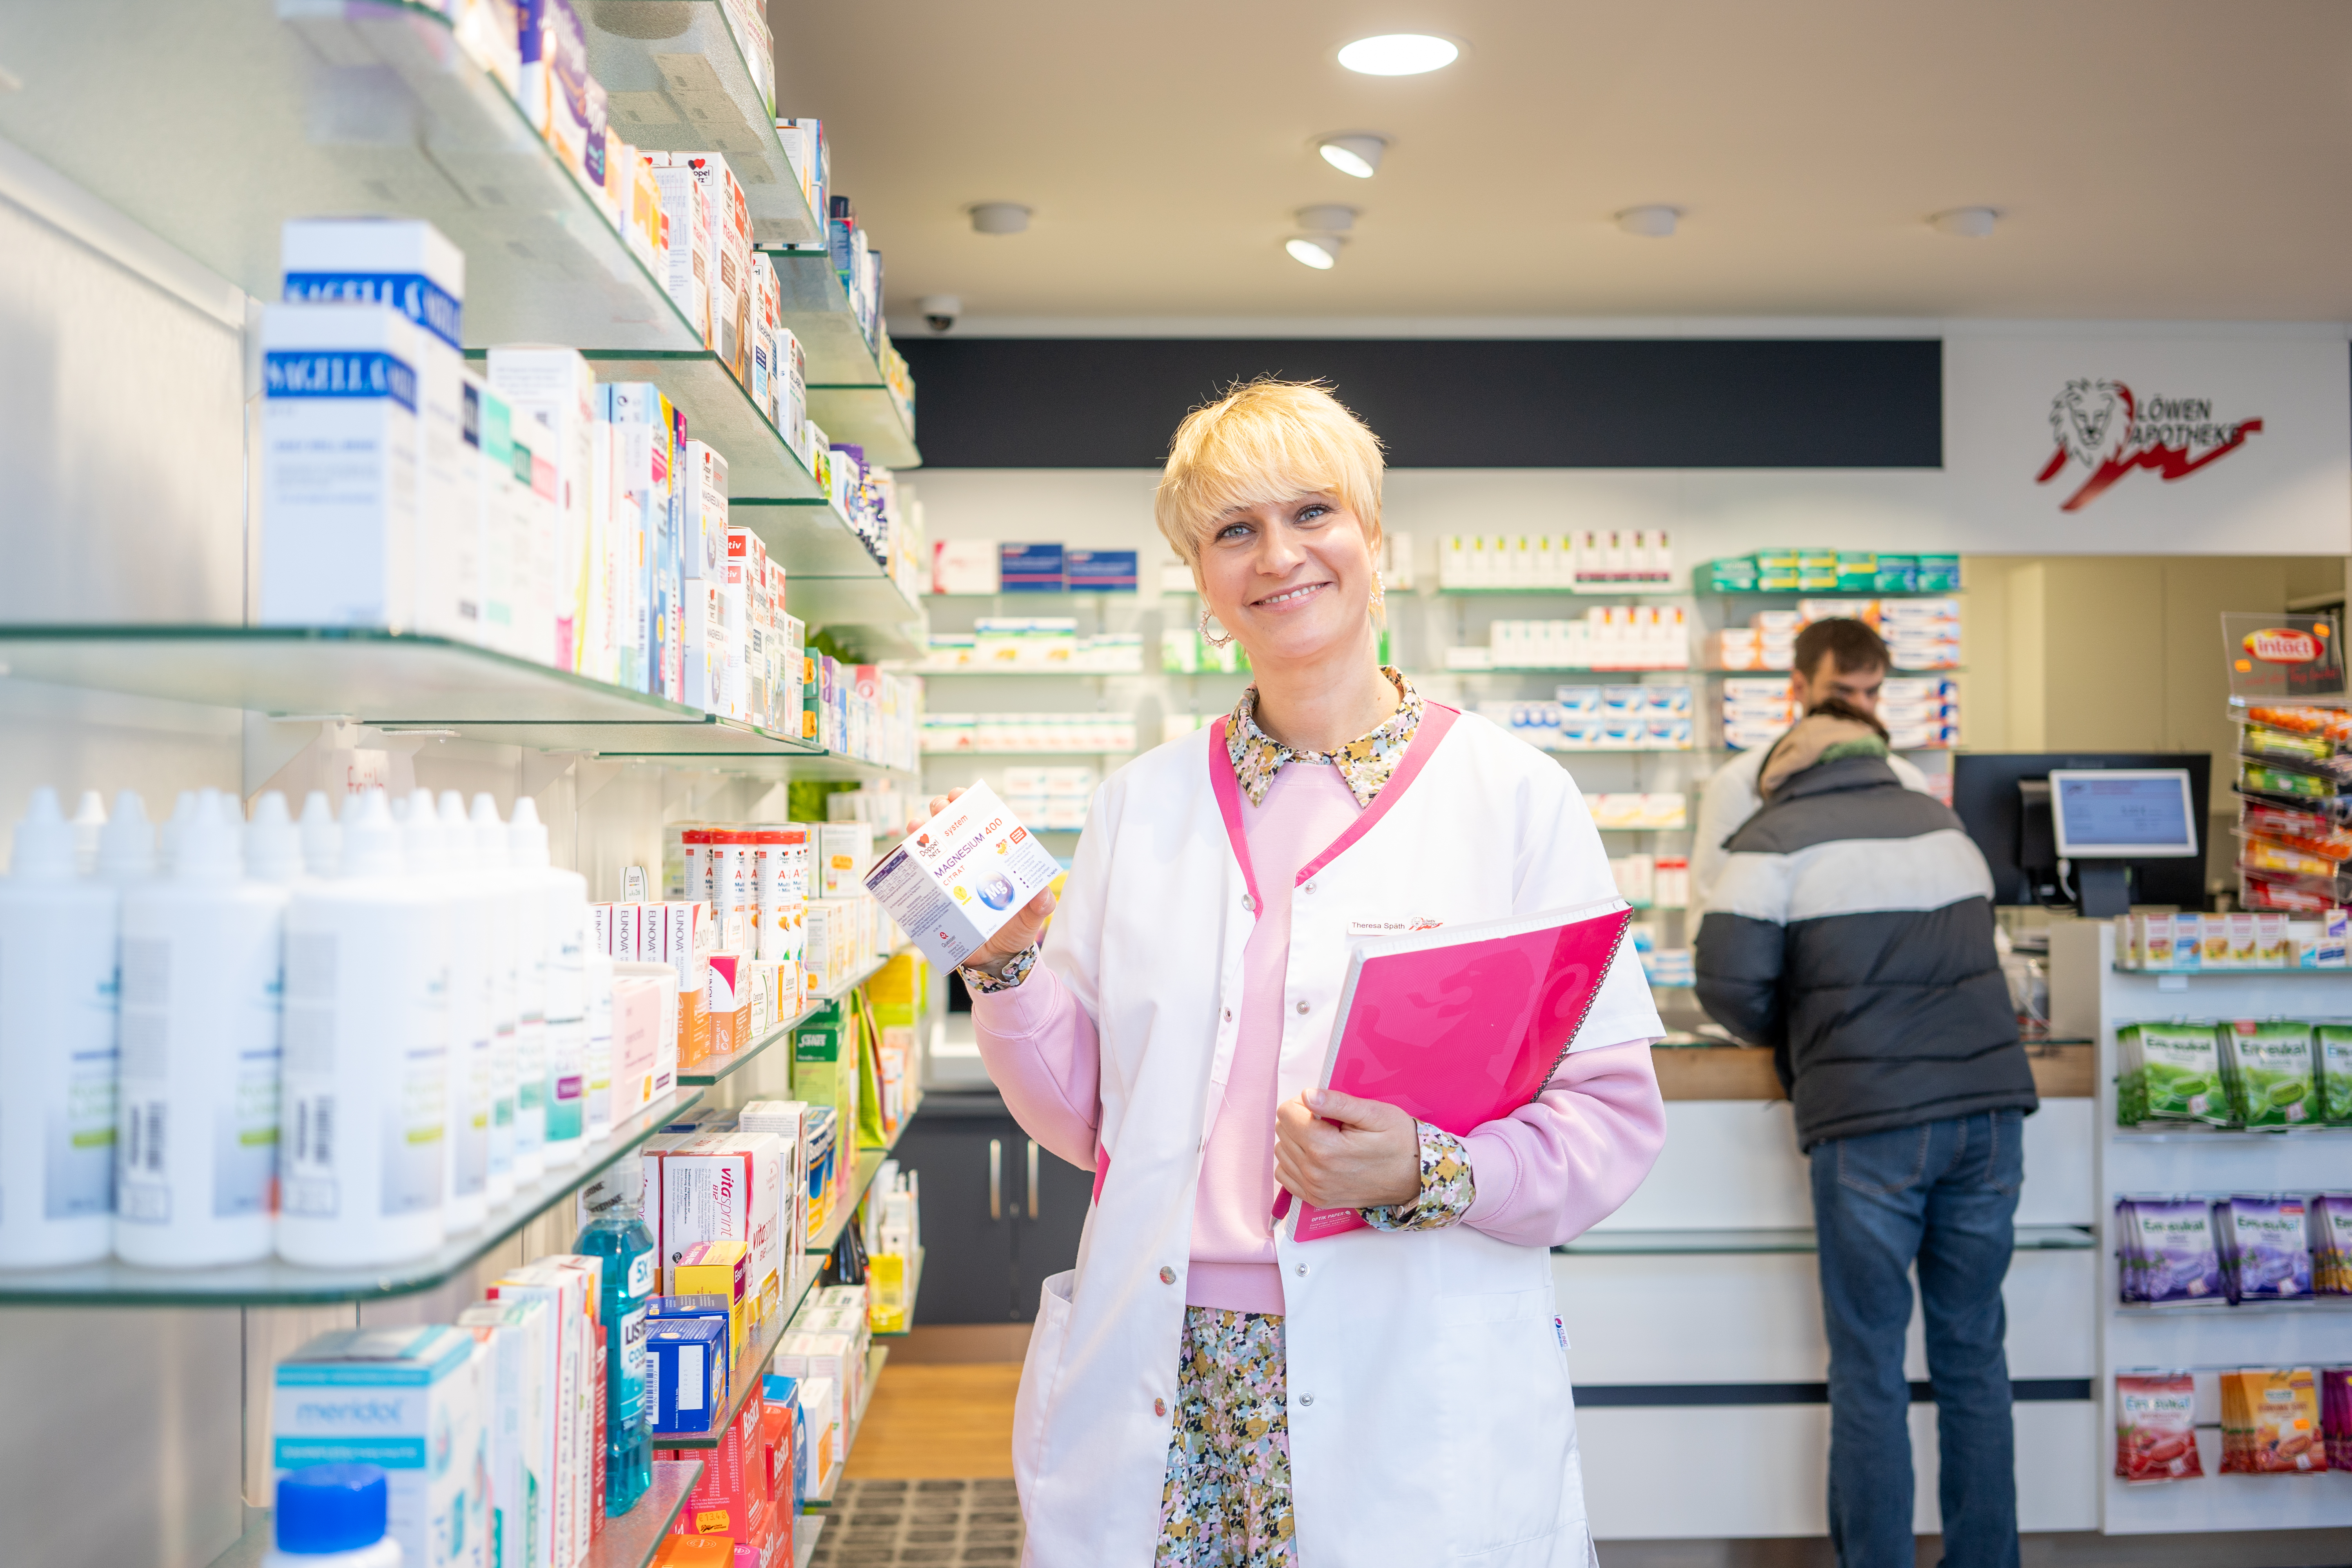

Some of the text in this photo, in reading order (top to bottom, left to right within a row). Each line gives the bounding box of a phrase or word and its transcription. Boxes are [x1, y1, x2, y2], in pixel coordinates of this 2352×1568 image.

[2135, 395, 2212, 421] LÖWEN
[2130, 424, 2241, 446] APOTHEKE
[2258, 635, 2311, 656] intact
[945, 815, 967, 836] system
[919, 839, 938, 856] Doppel
[927, 848, 940, 858] herz
[934, 833, 984, 877] MAGNESIUM
[985, 818, 1002, 834] 400
[943, 865, 964, 885] CITRAT
[984, 880, 1009, 902] Mg
[941, 935, 955, 947] Queisser
[715, 1168, 734, 1238] vitasprint
[743, 1398, 759, 1441] Basica
